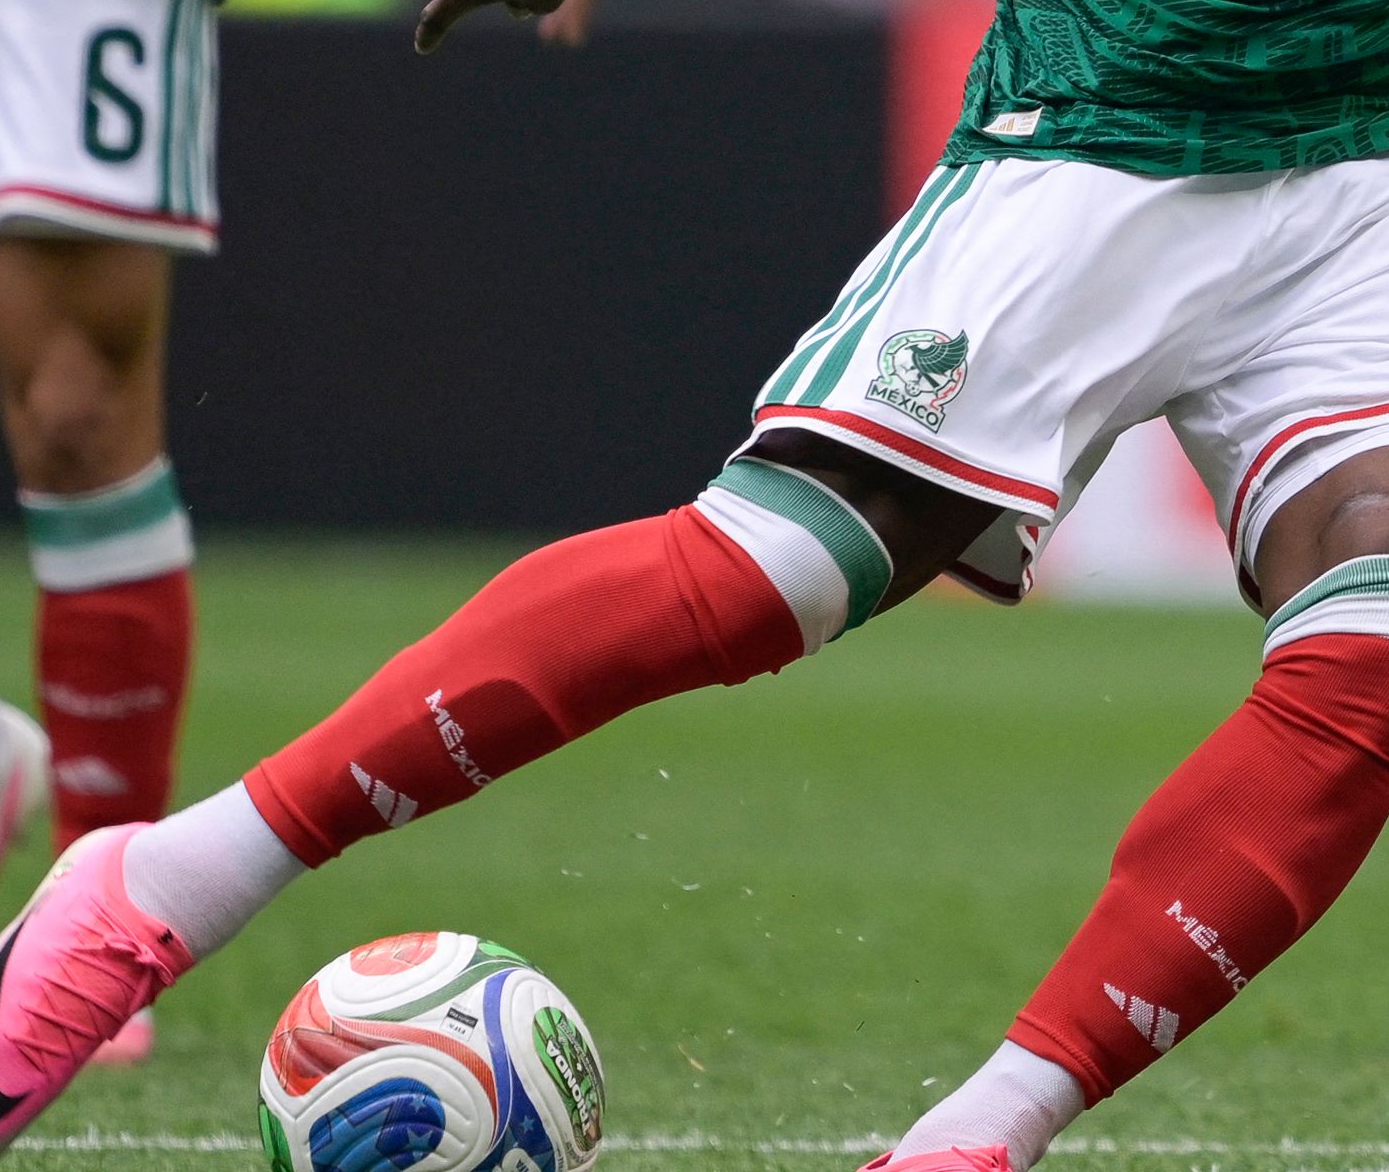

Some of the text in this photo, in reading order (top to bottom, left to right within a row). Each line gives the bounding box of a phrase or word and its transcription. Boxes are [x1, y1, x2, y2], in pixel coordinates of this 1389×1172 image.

[83, 27, 144, 164] 6
[870, 384, 939, 426] MÉXICO
[425, 689, 492, 786] MÉXIC
[1165, 900, 1248, 992] MÉXIC
[545, 1039, 592, 1137] TRIONDA
